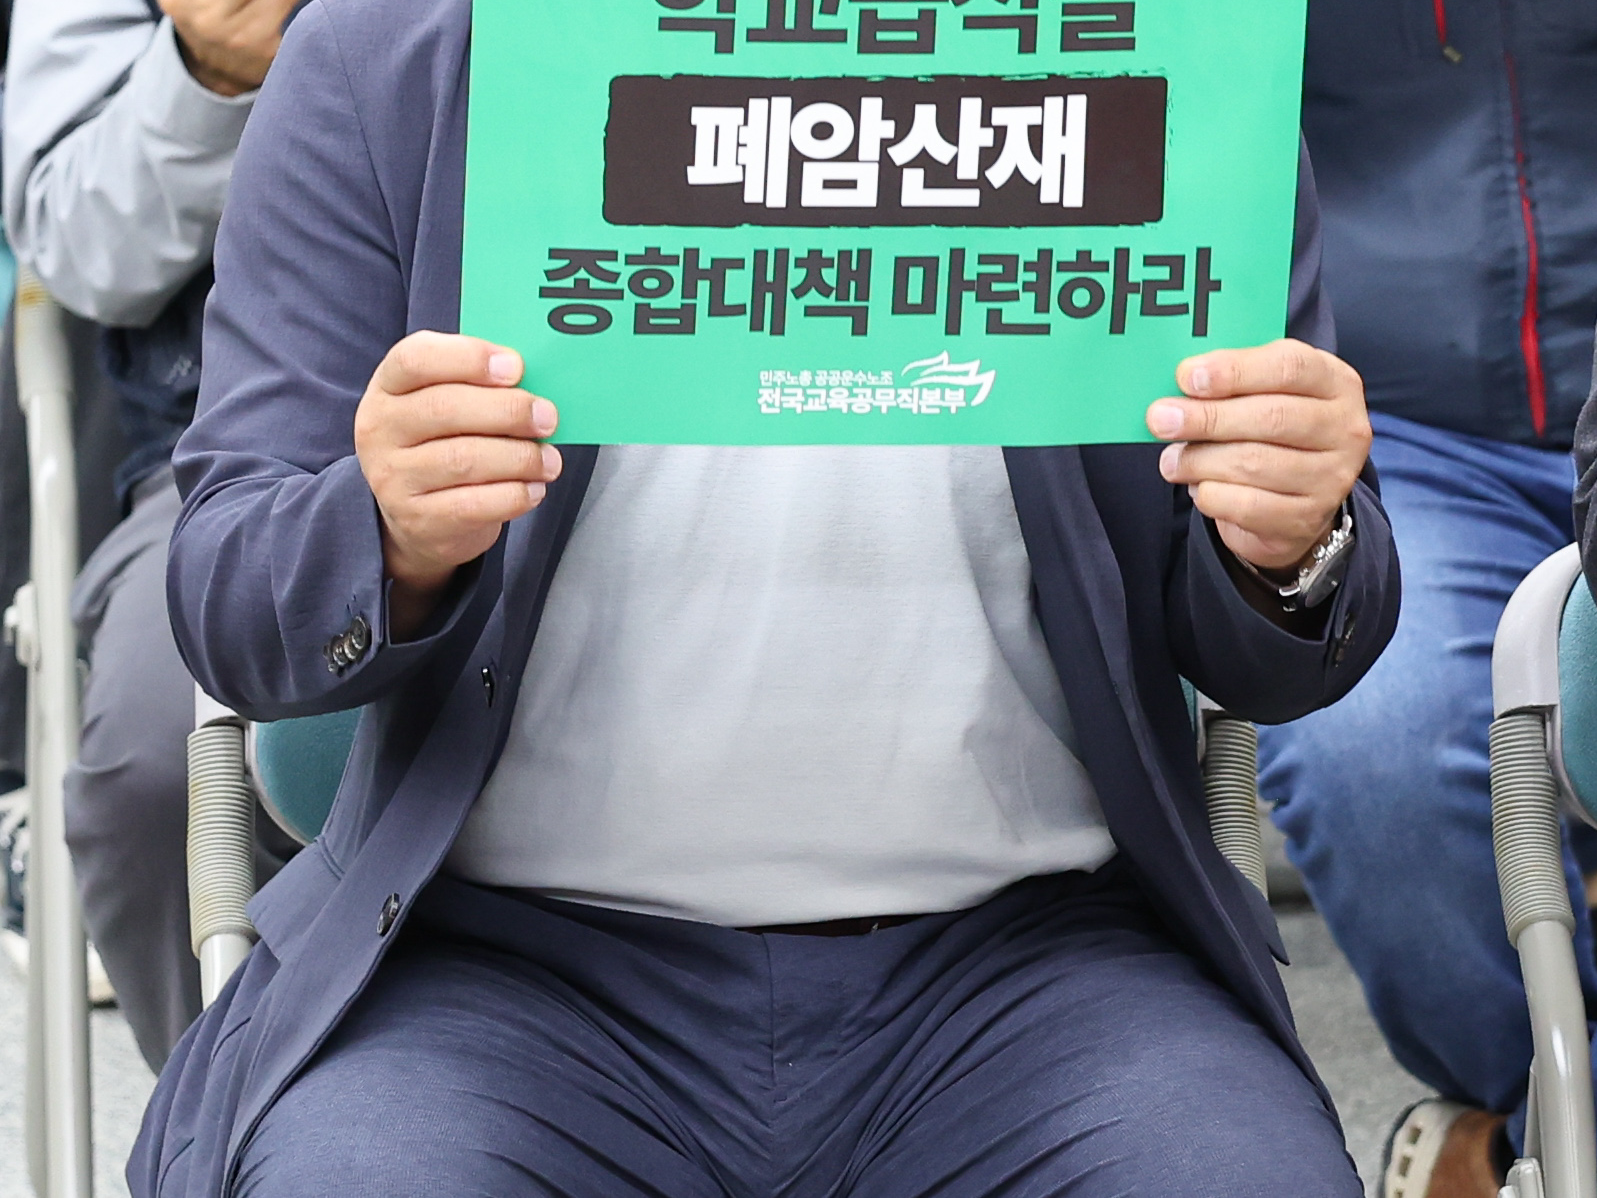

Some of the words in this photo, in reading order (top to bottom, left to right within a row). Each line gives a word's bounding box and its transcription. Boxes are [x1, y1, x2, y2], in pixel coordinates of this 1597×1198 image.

[686, 94, 1088, 208] 폐암산재
[538, 247, 874, 337] 종합대책
[890, 247, 1222, 337] 마련하라
[757, 387, 967, 414] 전국교육공무직본부
[759, 369, 813, 387] 민주노총
[814, 369, 894, 387] 공공운수노조
